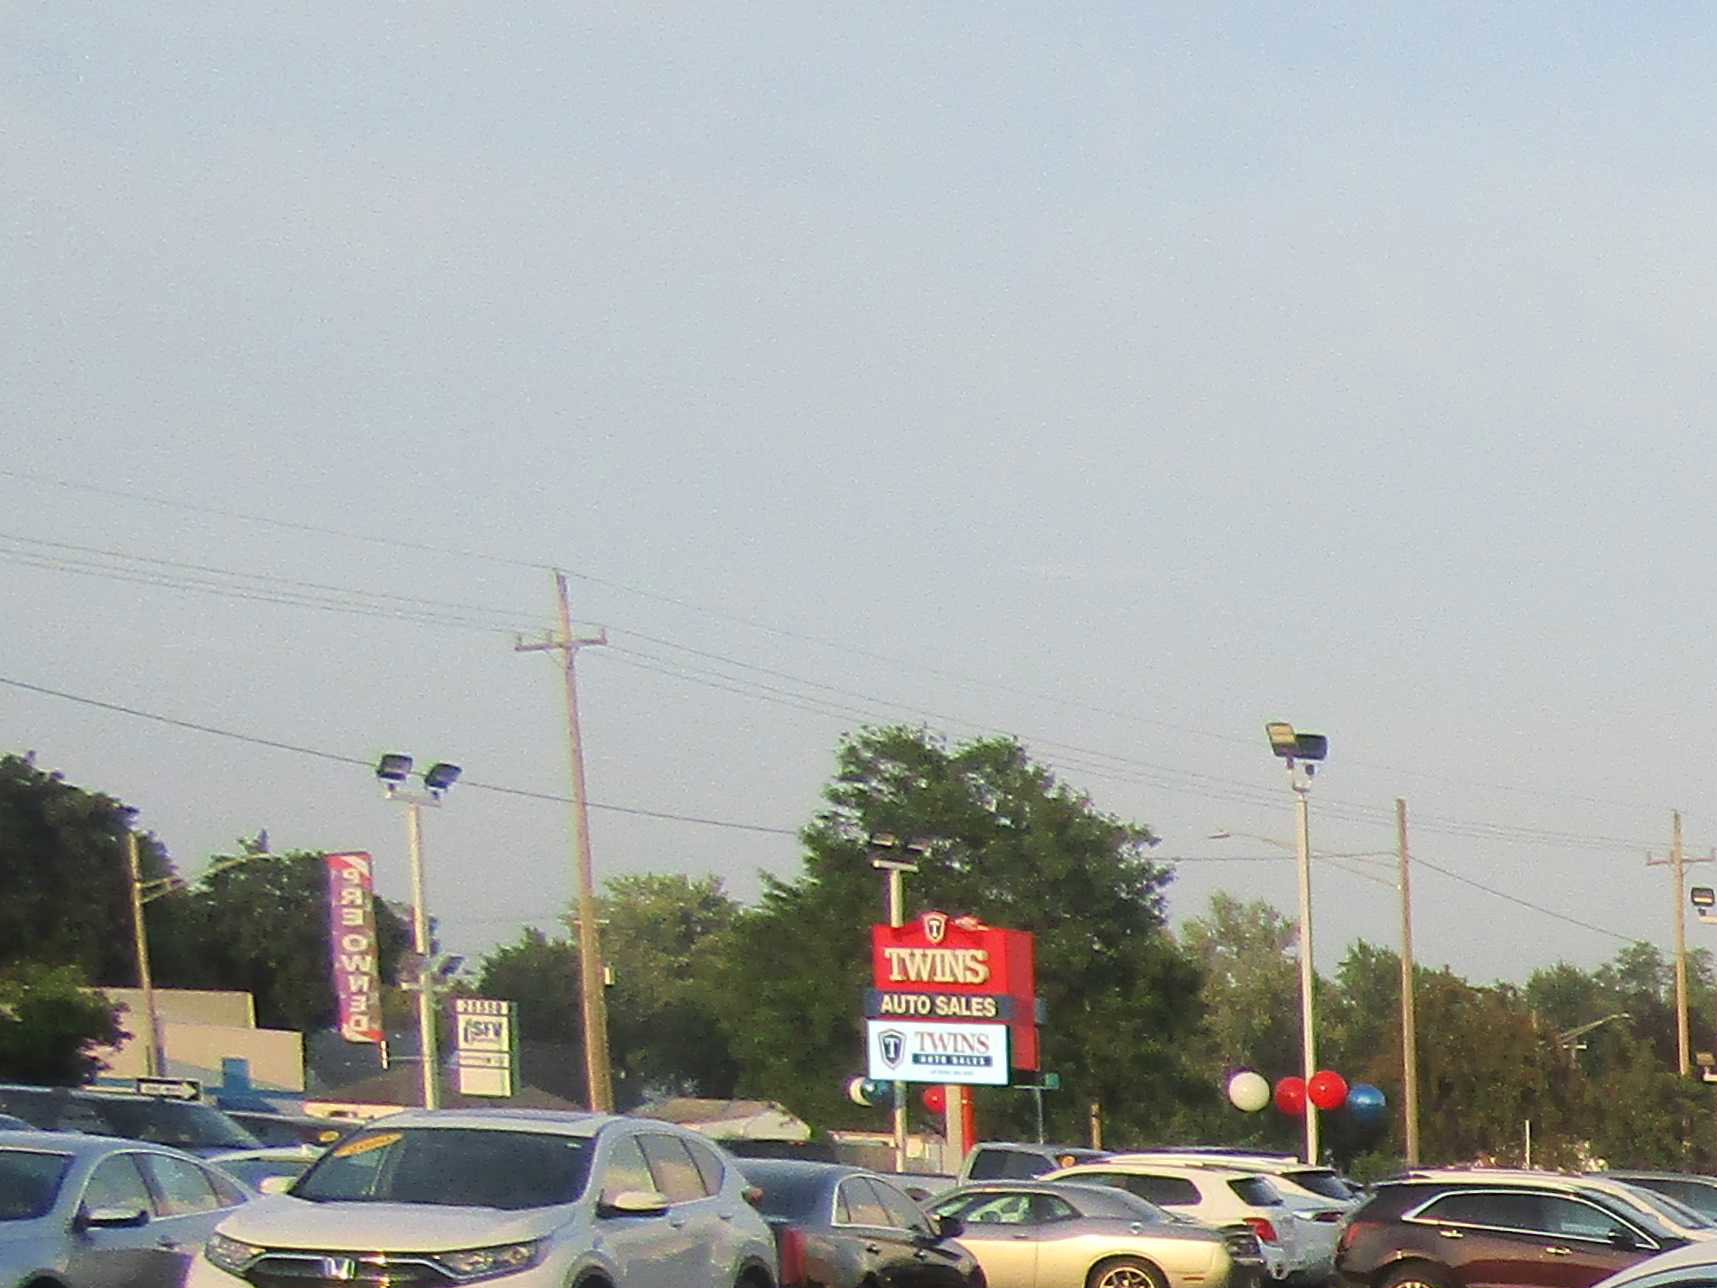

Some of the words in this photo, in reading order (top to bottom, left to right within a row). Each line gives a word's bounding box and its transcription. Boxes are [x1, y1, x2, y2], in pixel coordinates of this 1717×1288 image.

[341, 867, 364, 927] PRE
[341, 932, 372, 1031] OWNED
[884, 948, 990, 985] TWINS
[881, 994, 931, 1016] AUTO
[935, 995, 997, 1017] SALES
[915, 1031, 990, 1053] TWINS
